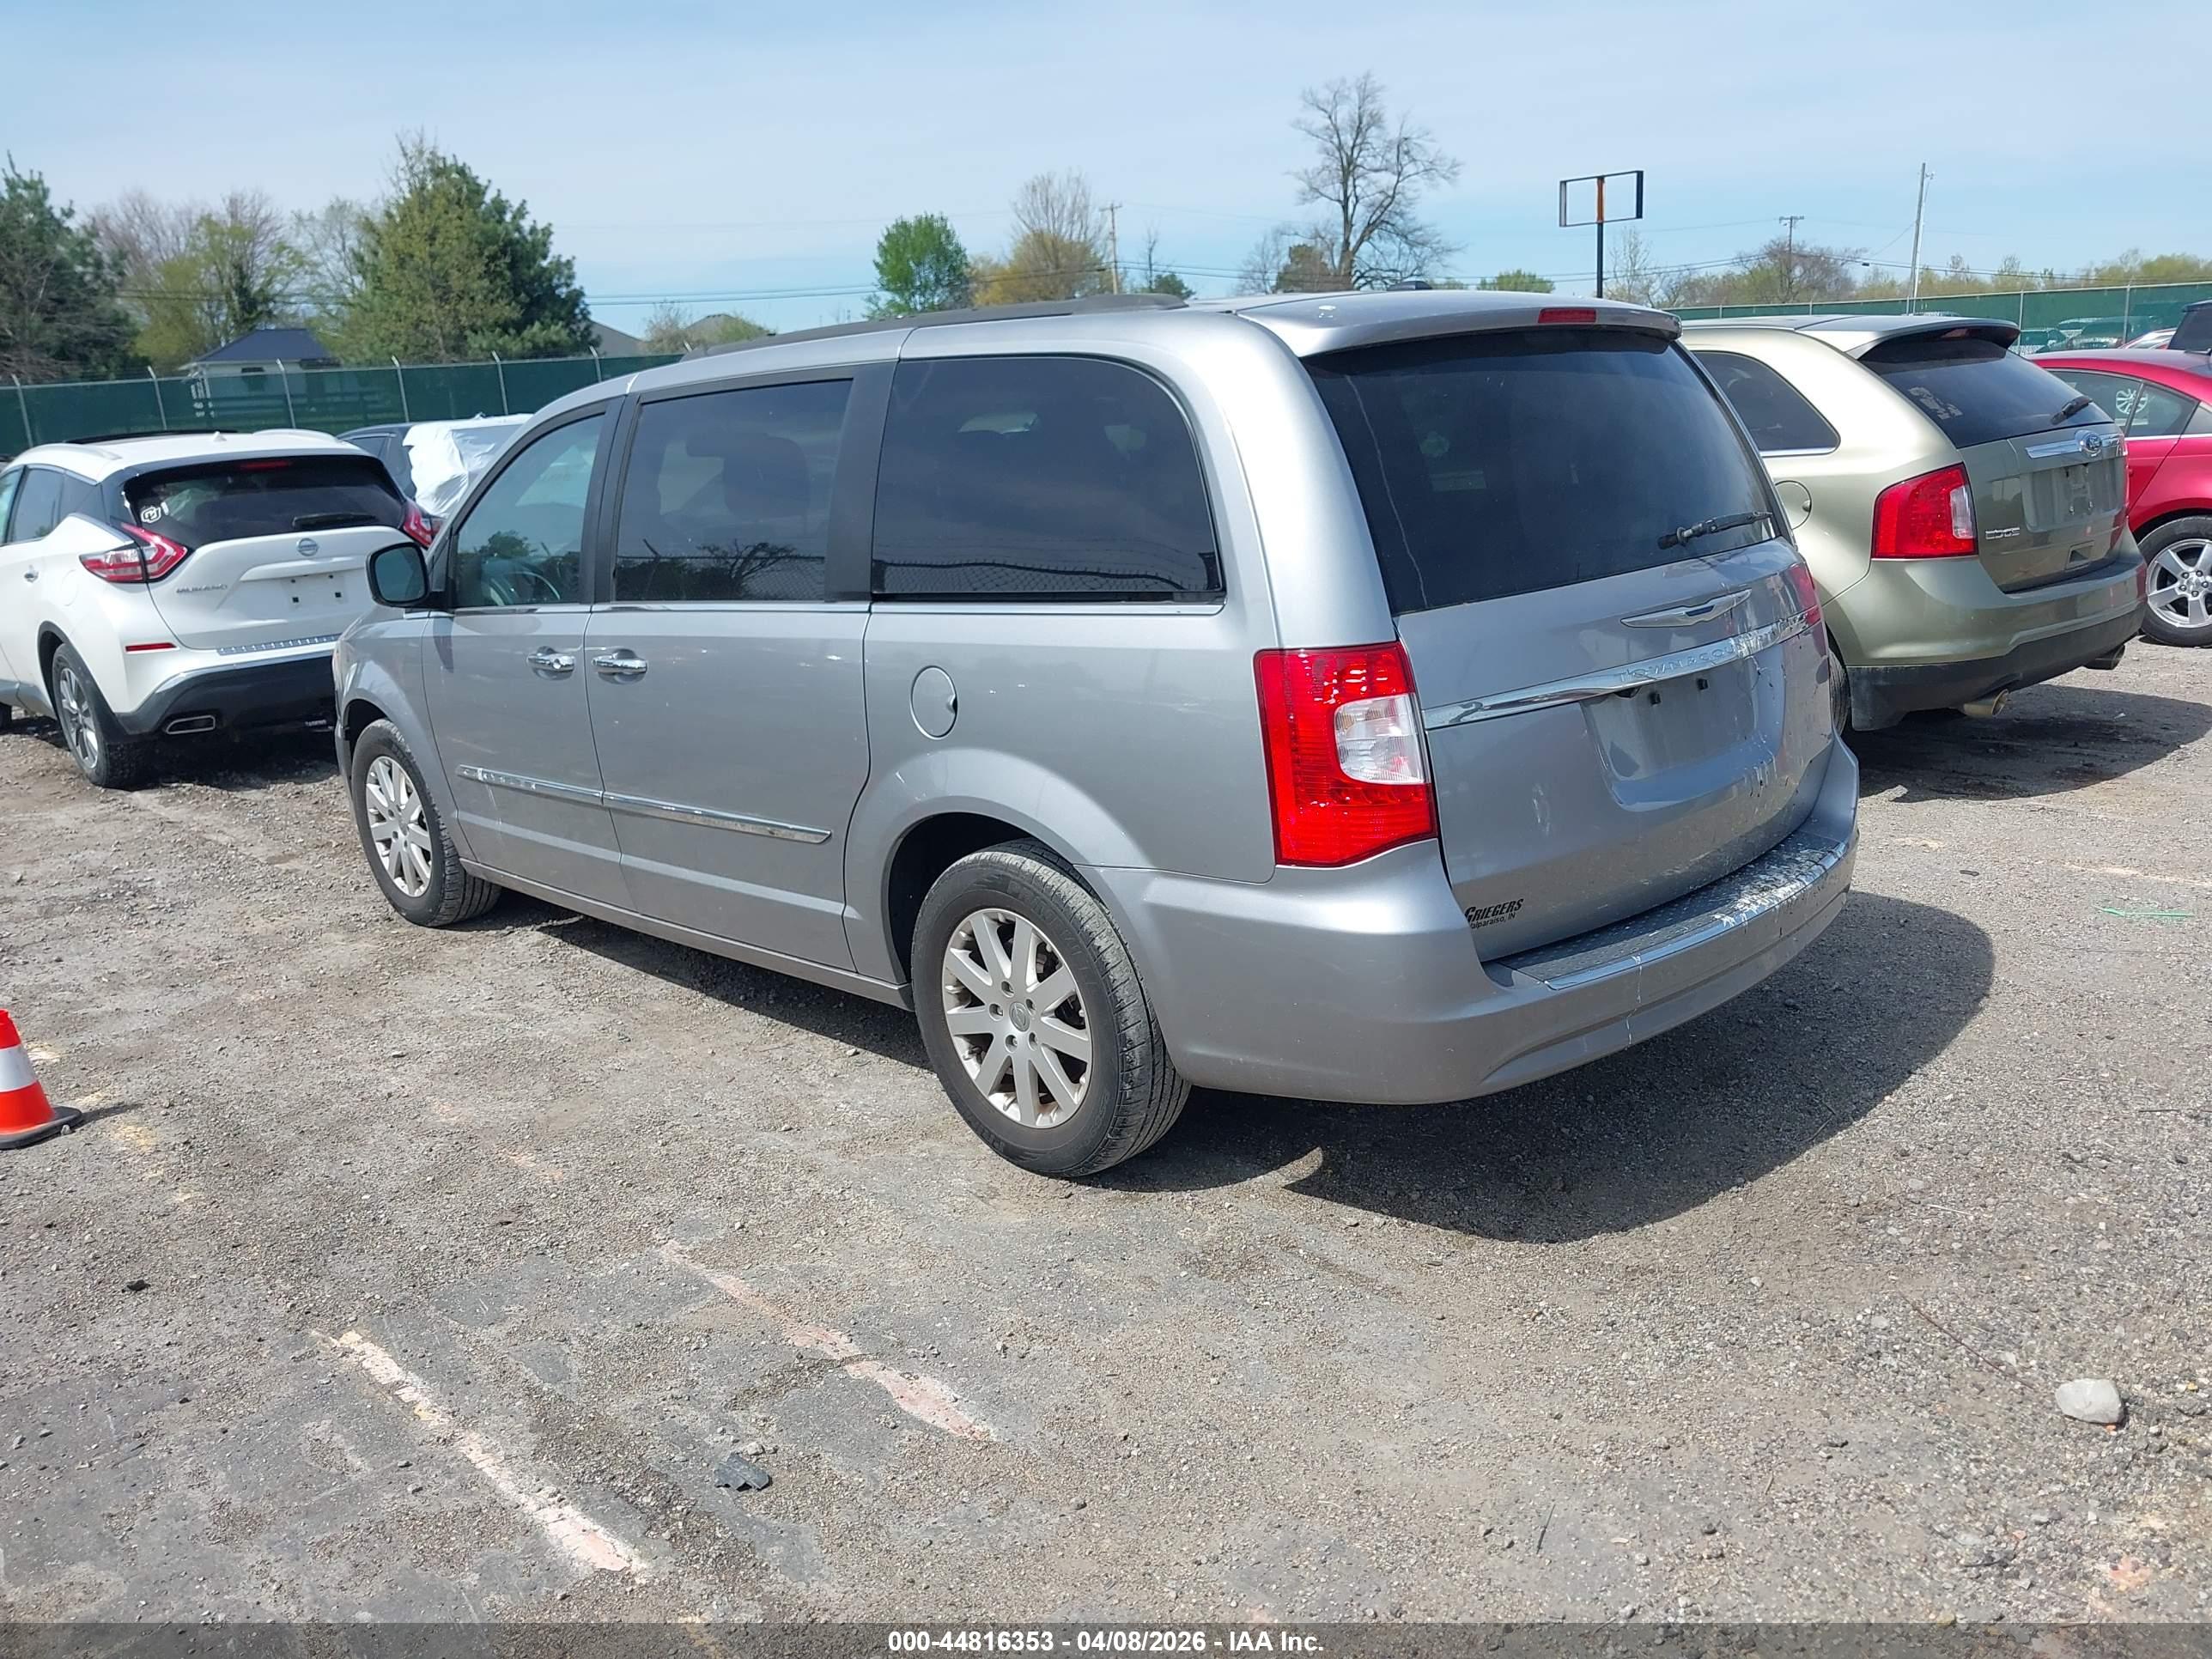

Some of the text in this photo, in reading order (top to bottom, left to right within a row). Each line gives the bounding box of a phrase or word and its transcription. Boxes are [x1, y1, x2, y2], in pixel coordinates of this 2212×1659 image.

[1985, 527, 2020, 539] EDGE
[1464, 898, 1524, 922] GRIEGERS
[1470, 912, 1516, 929] alparaiso, IN
